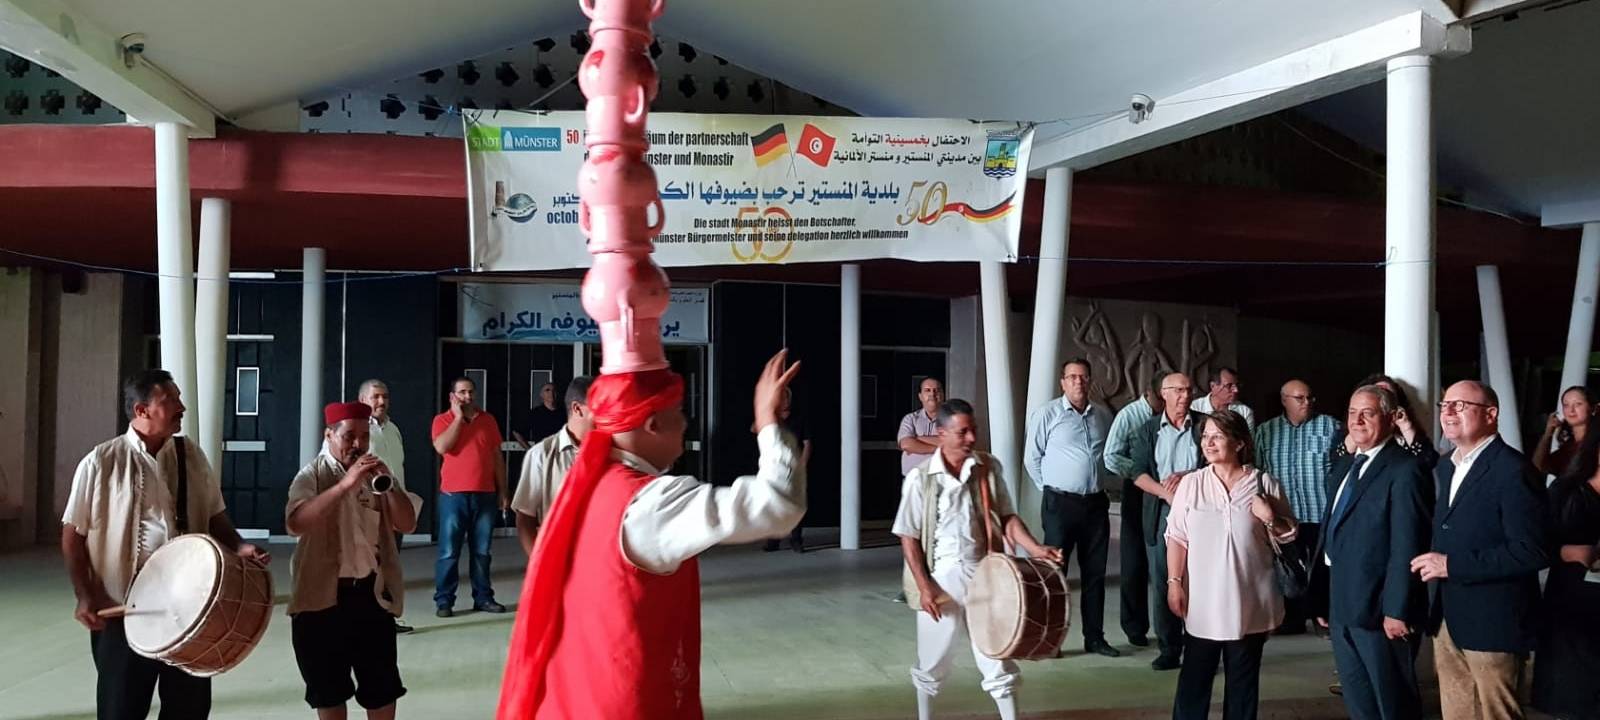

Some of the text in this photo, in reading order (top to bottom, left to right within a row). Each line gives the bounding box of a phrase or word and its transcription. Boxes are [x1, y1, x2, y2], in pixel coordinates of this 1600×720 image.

[514, 135, 558, 148] MÜNSTER
[566, 129, 579, 145] 50
[668, 131, 684, 145] der
[686, 131, 749, 147] partnerschaft
[644, 151, 734, 166] nster und Monastir
[700, 180, 759, 205] بضيوفها
[762, 180, 805, 206] ترحب
[808, 180, 858, 206] المنستير
[861, 180, 900, 205] بلدية
[896, 180, 948, 226] 50
[547, 209, 579, 224] octob
[694, 218, 707, 229] Die
[708, 218, 730, 229] stadt
[731, 217, 766, 228] Monastir
[794, 218, 808, 227] den
[687, 232, 746, 244] Bürgermeister
[747, 231, 763, 242] und
[787, 230, 829, 242] delegation
[831, 229, 861, 240] herzlich
[862, 229, 909, 240] willkommen
[482, 311, 541, 337] الكرام
